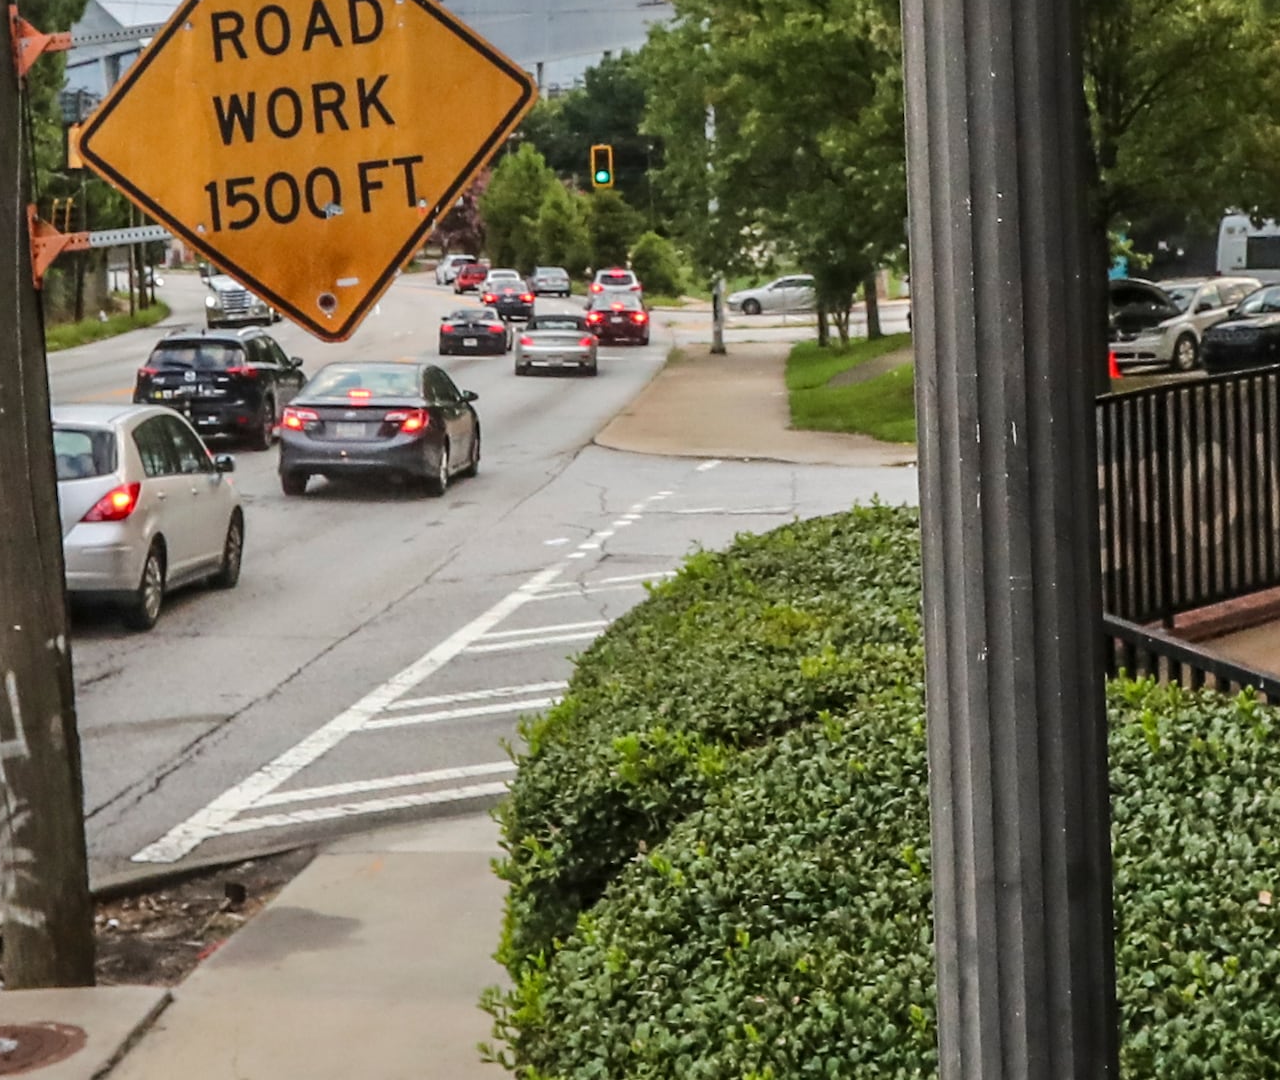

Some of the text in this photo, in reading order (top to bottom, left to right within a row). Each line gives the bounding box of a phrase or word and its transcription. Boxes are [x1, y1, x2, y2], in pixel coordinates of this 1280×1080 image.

[213, 74, 396, 146] WORK
[204, 155, 424, 233] 1500 FT
